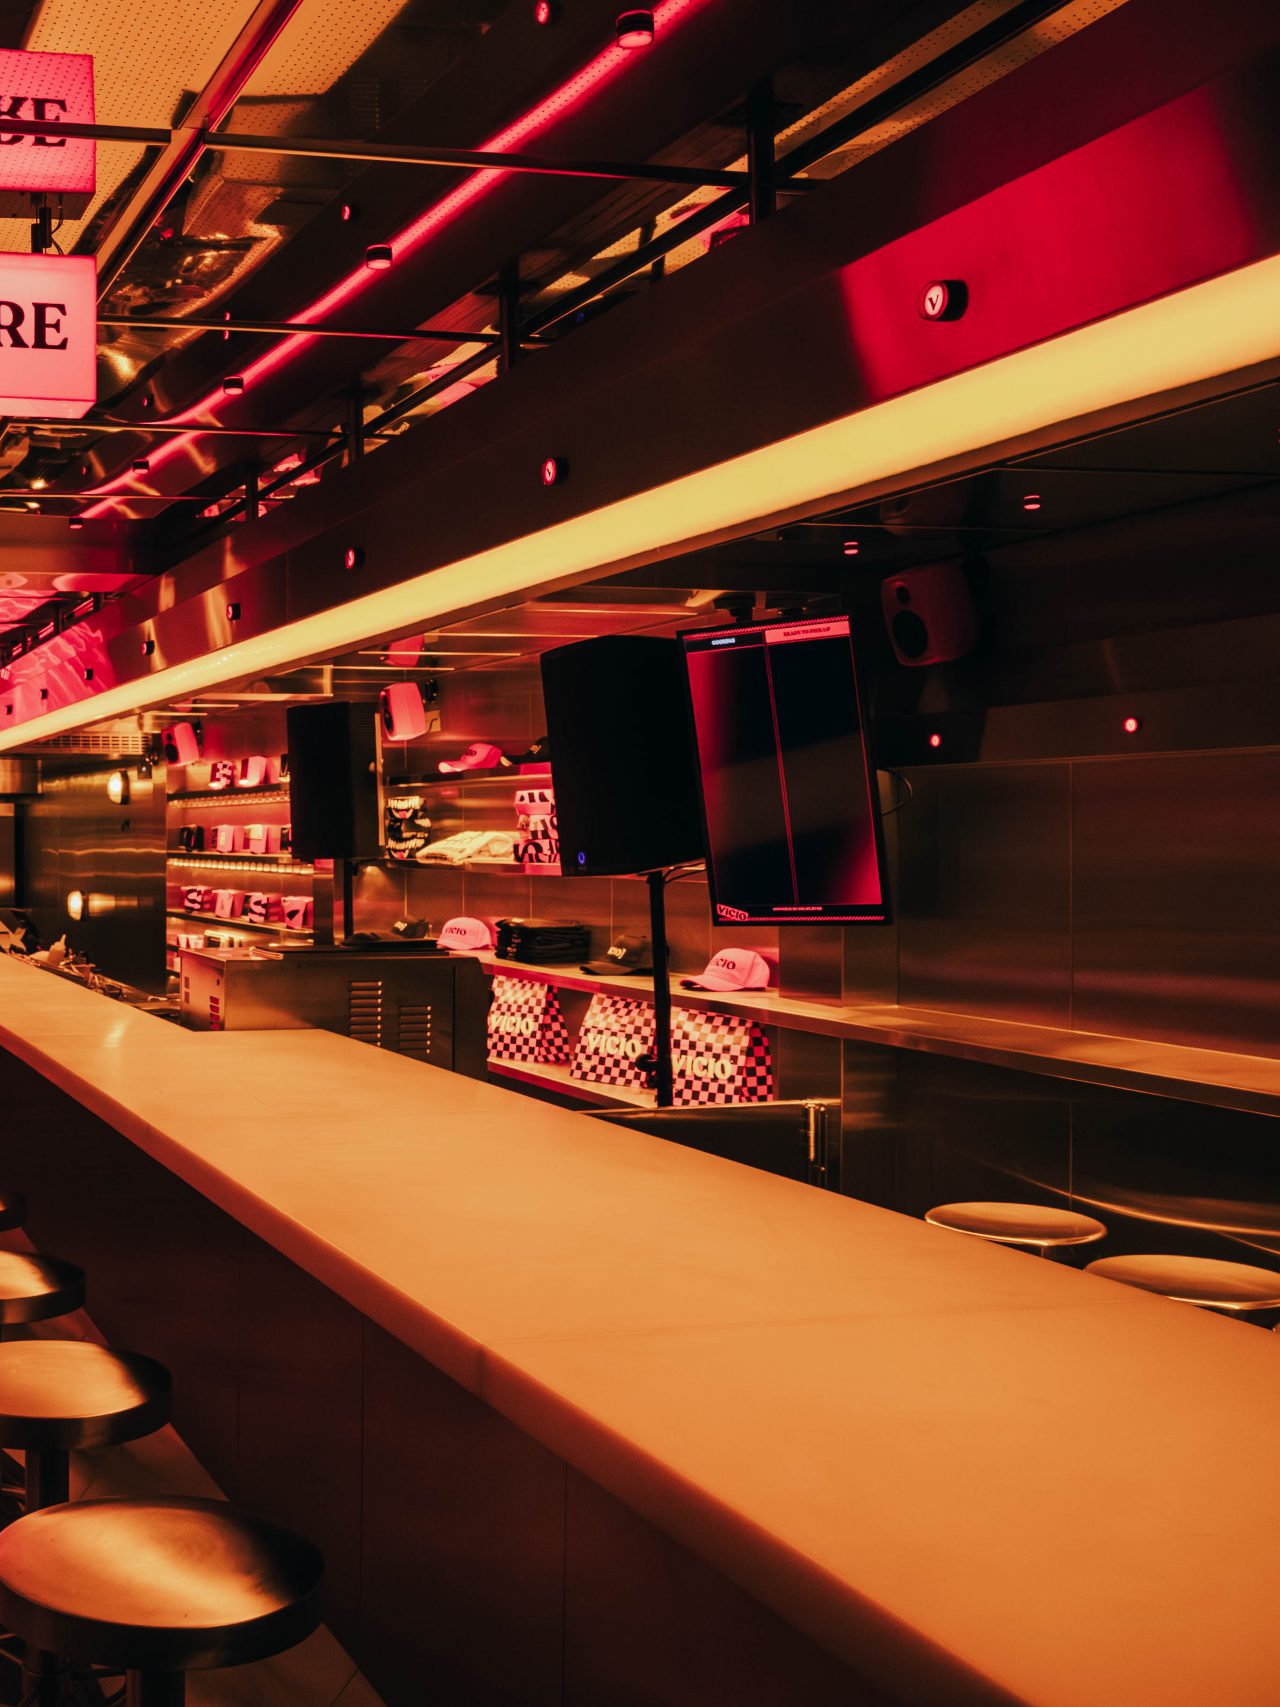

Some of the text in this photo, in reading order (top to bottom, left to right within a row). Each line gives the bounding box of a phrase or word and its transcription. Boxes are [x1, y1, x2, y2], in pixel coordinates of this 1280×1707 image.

[718, 905, 747, 921] VICIO
[490, 1014, 534, 1035] VICIO
[587, 1033, 642, 1058] VICIO
[671, 1055, 732, 1080] VICIO
